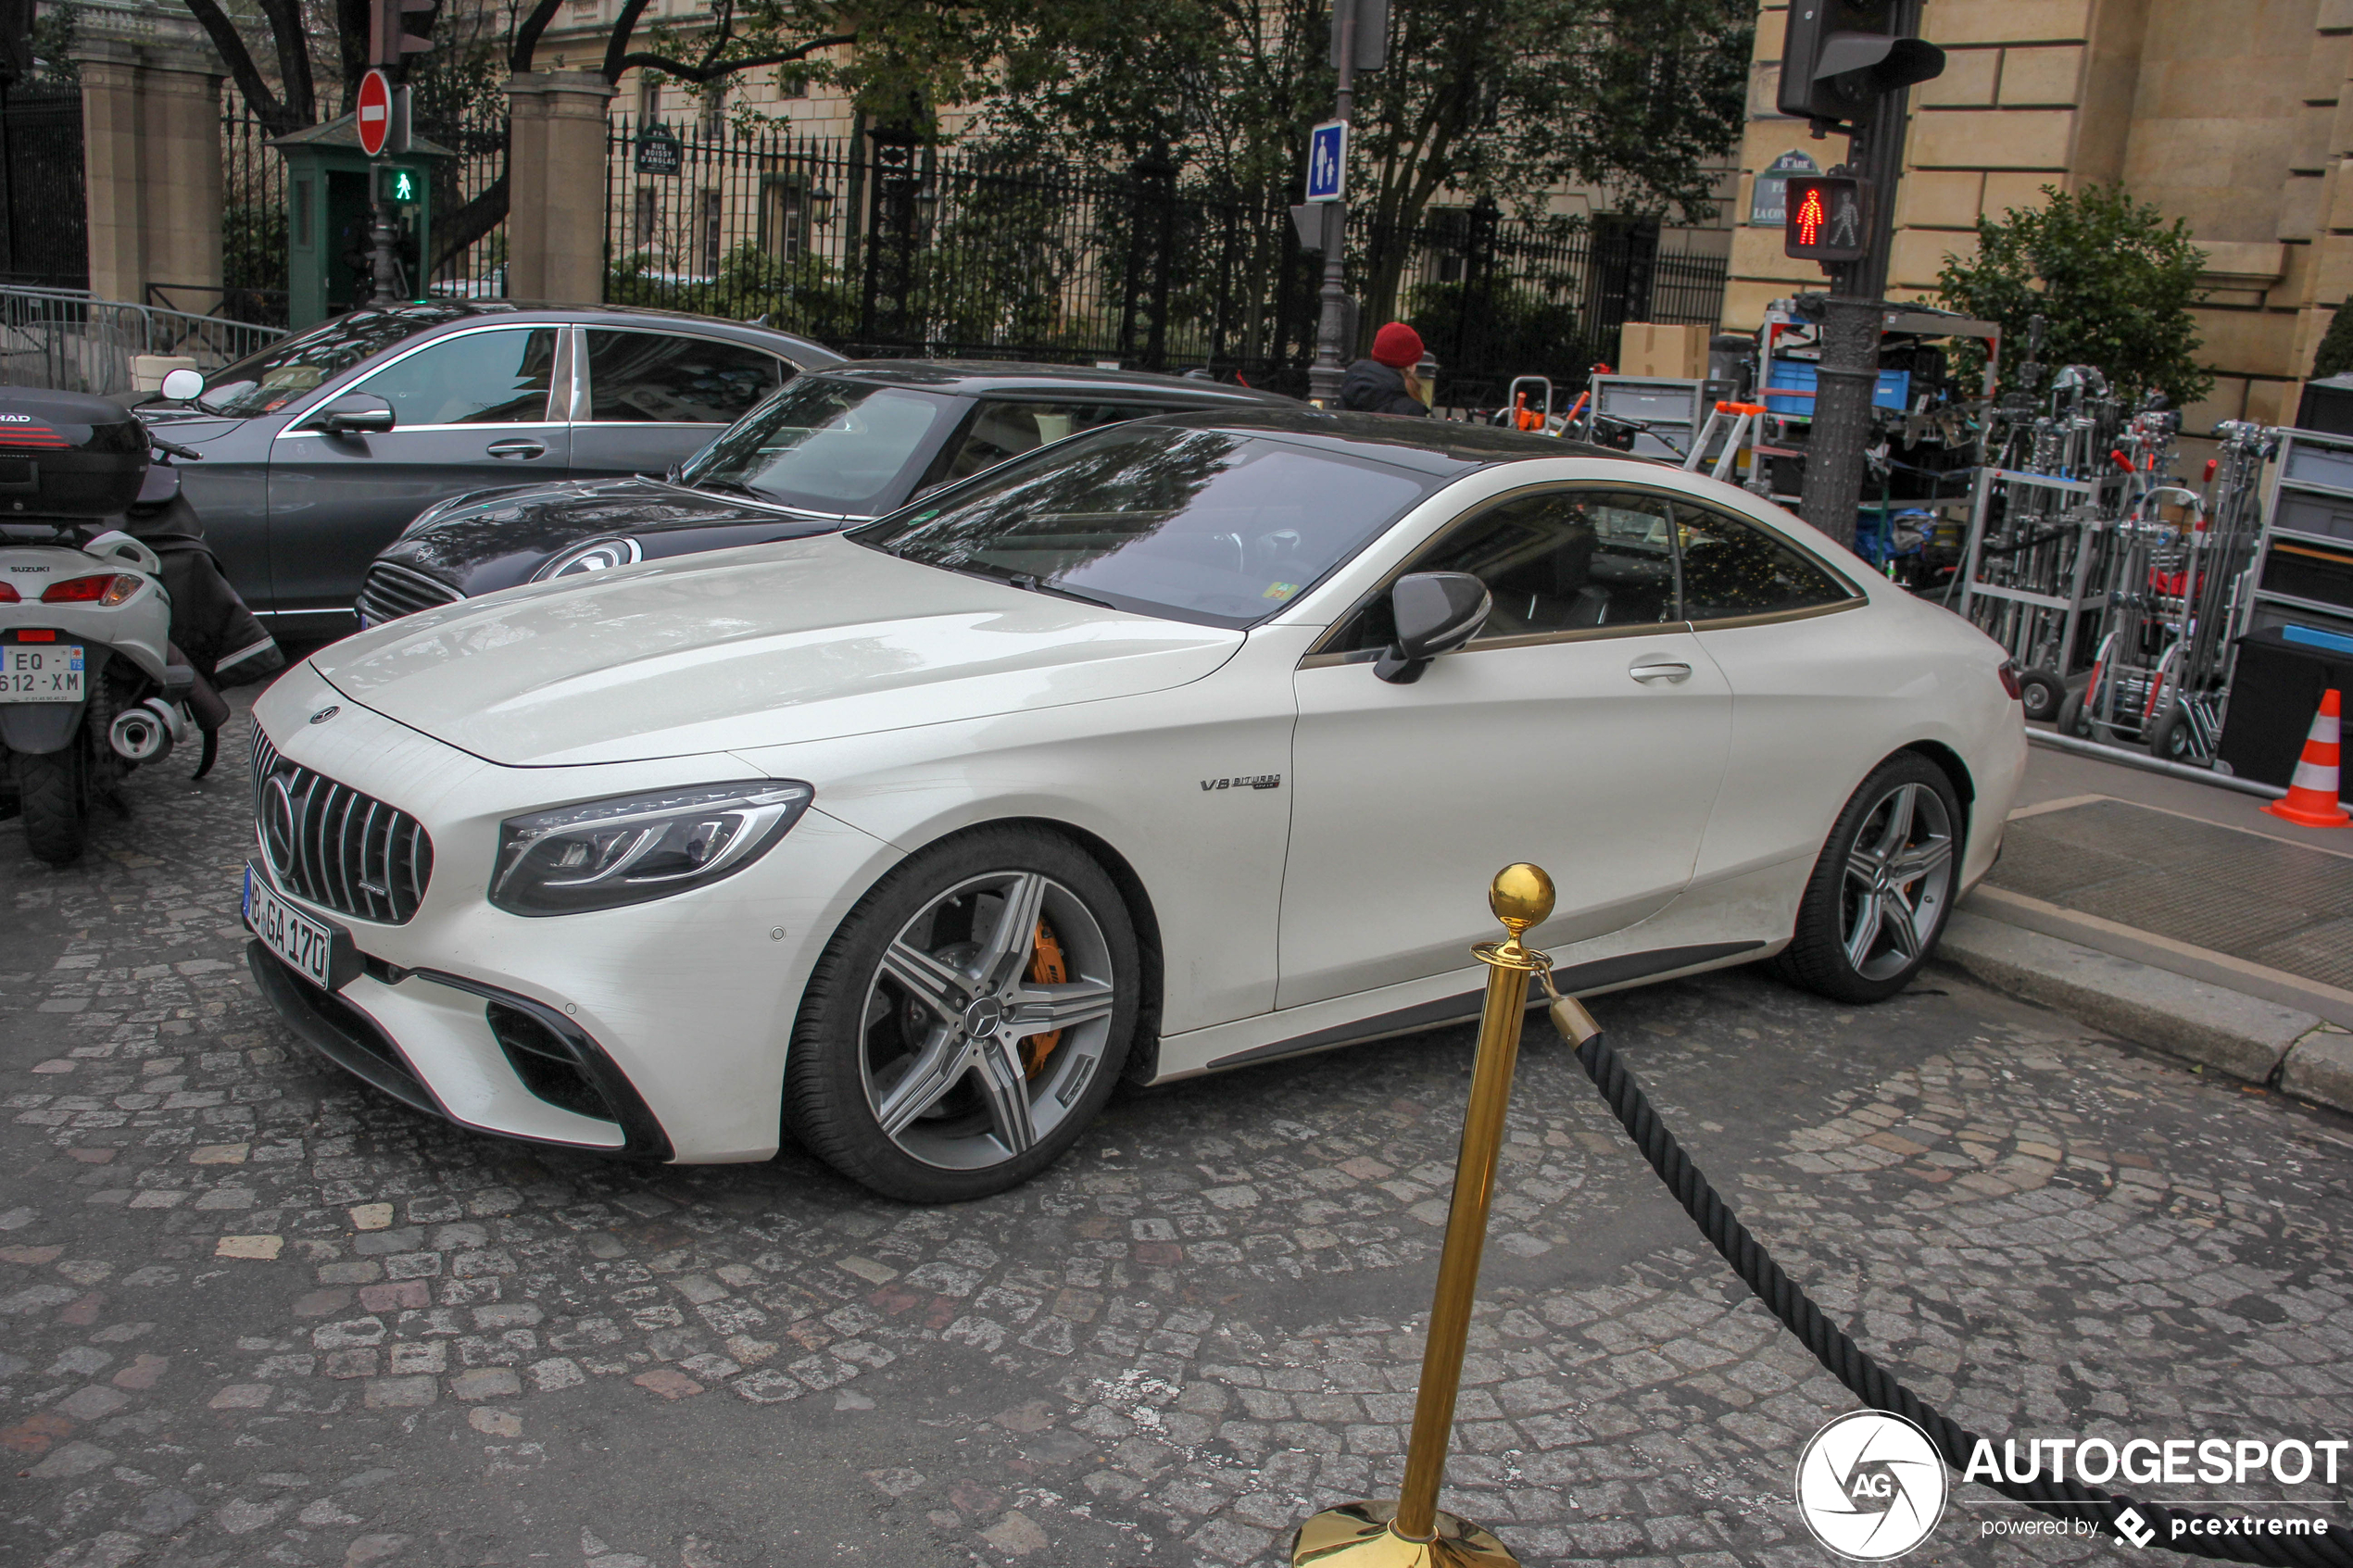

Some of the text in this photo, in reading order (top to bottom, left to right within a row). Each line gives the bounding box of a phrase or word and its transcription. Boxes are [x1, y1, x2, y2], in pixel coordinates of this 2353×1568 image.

[646, 149, 673, 157] BOISSY
[641, 156, 676, 165] D'ANGLAS
[1772, 182, 1786, 193] PL
[17, 653, 43, 671] EQ
[72, 660, 82, 669] 75
[1201, 774, 1281, 791] V8 BITURBO
[267, 898, 285, 952] GA
[289, 918, 326, 978] 170
